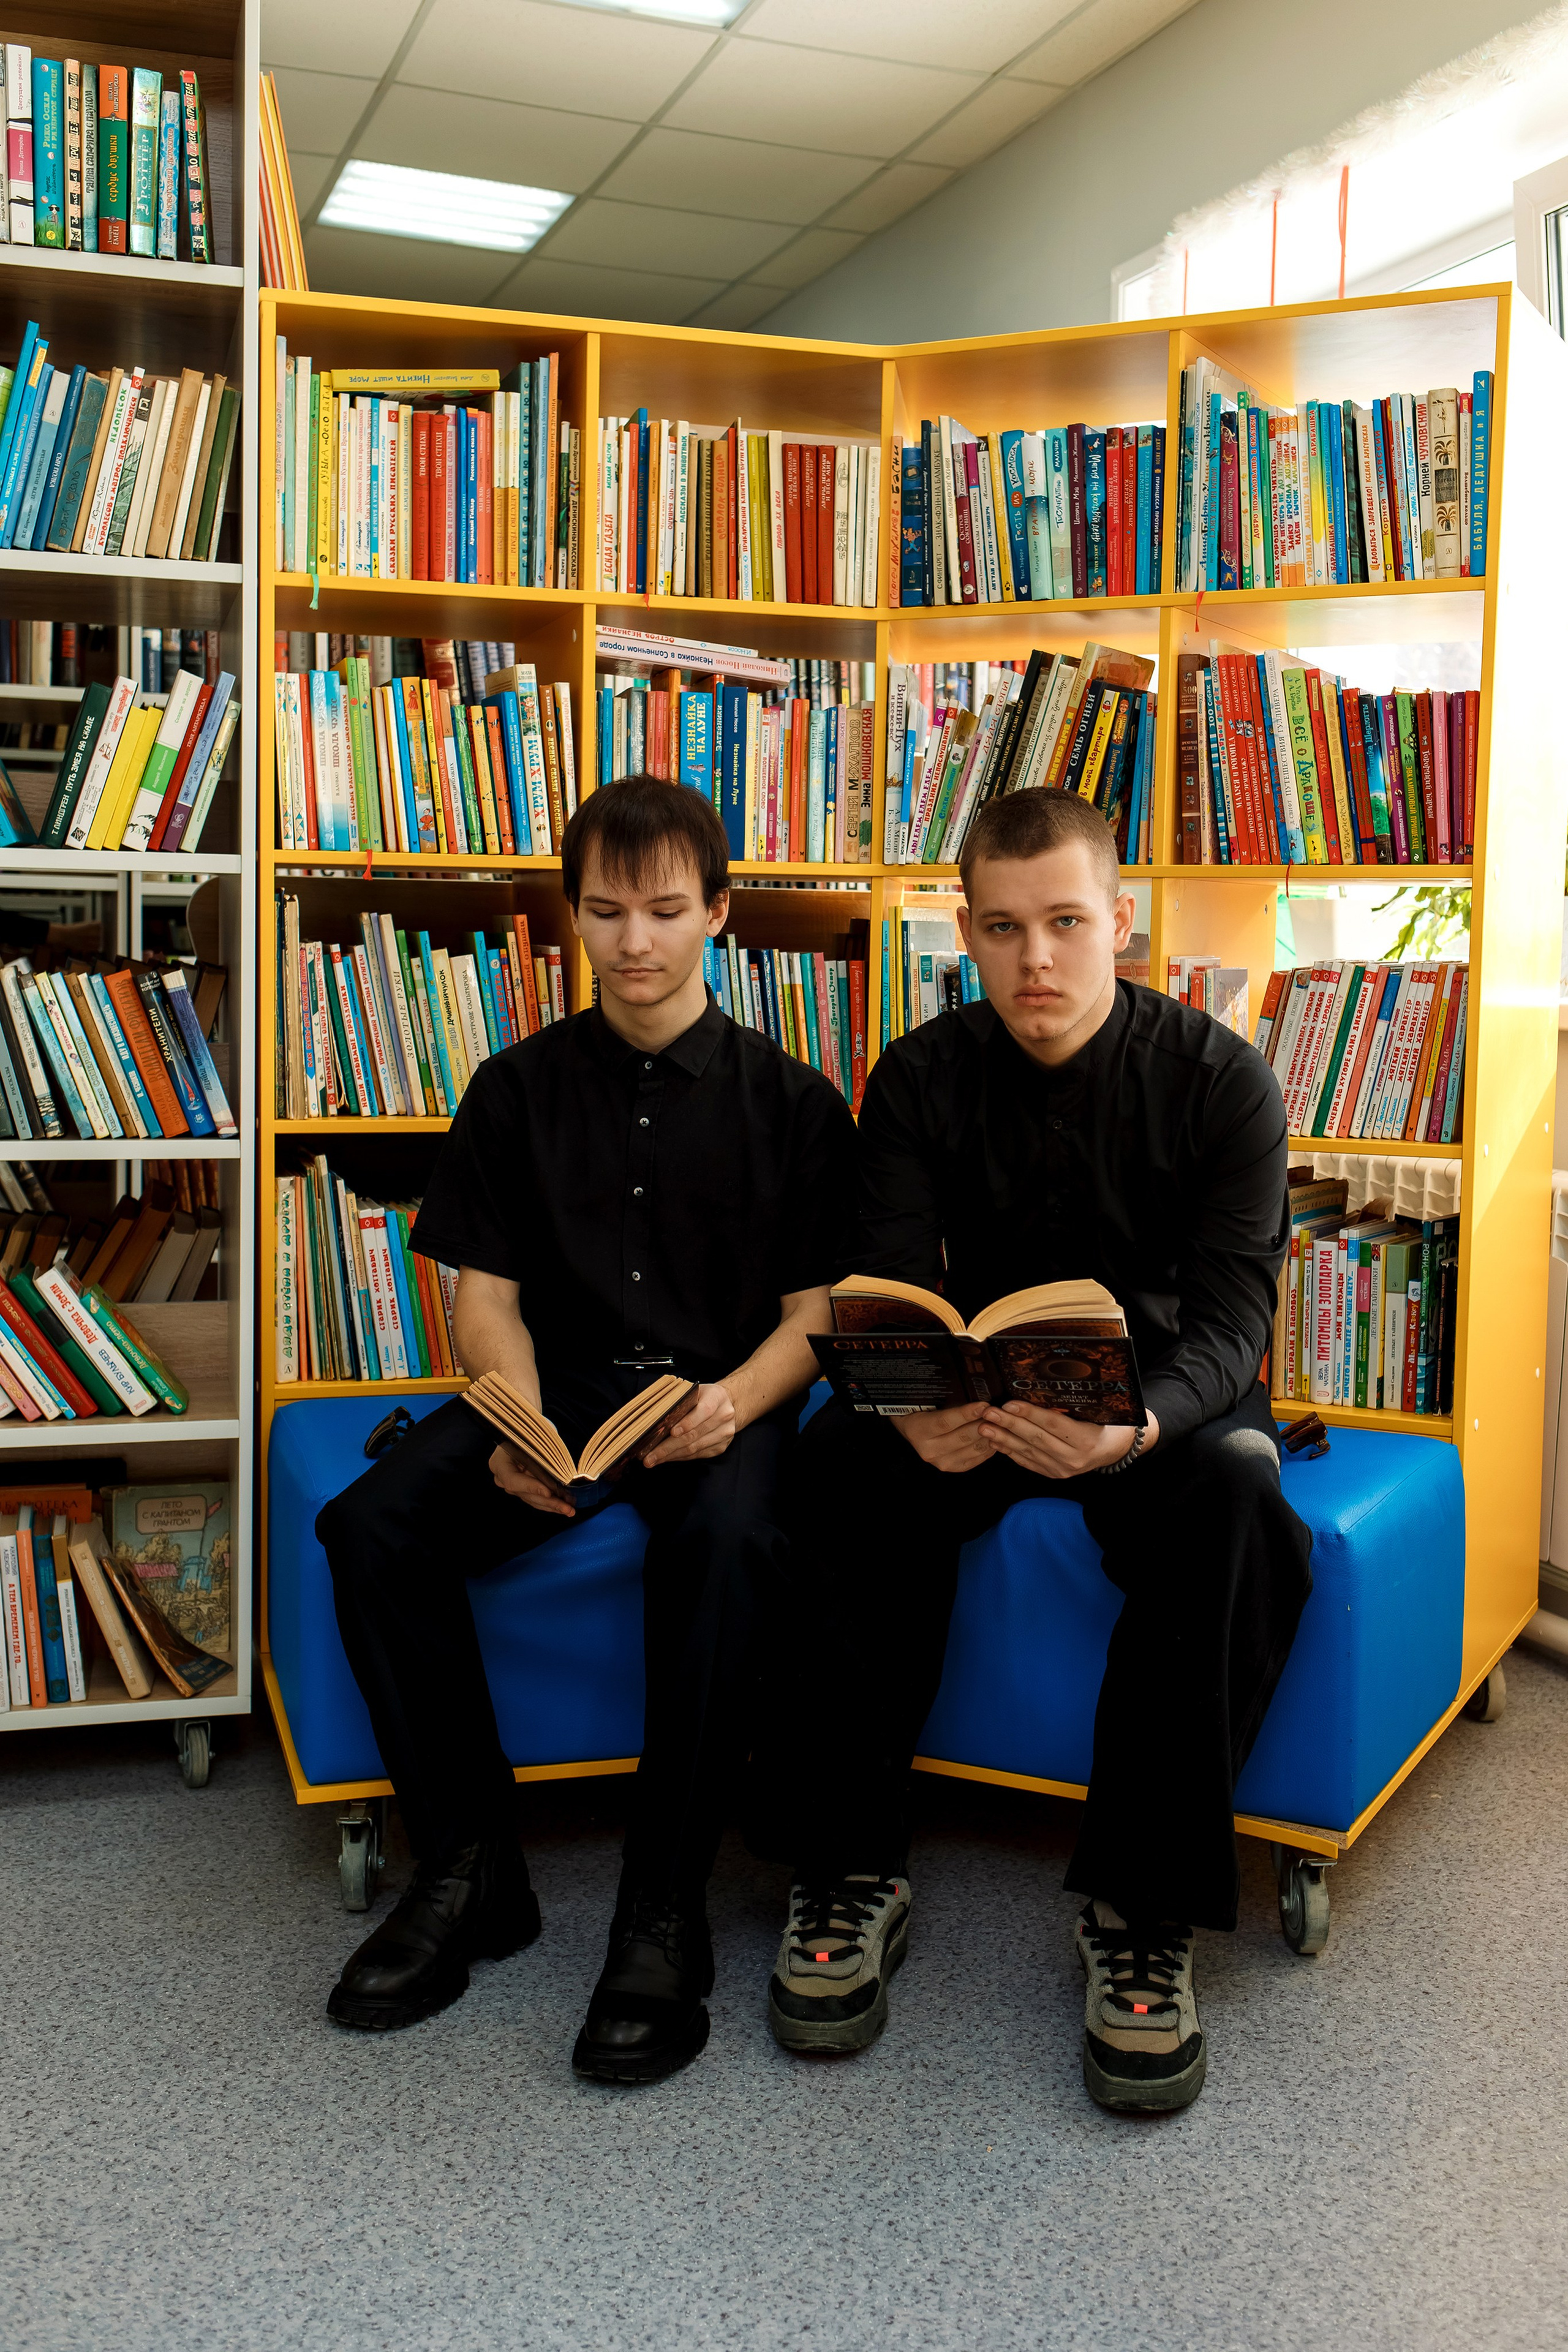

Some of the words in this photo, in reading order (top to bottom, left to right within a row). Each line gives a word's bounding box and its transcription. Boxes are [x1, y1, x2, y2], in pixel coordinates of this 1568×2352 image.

[189, 158, 200, 183] ДЕЛО
[1417, 404, 1428, 460] ЧУКОВСКИЙ
[1420, 462, 1431, 497] Корней
[1474, 436, 1485, 493] ДЕДУШКА
[1013, 493, 1021, 505] ИЗ
[1365, 486, 1376, 526] ЗАПРЕЩЕНО!
[1473, 500, 1483, 549] БАБУЛЯ,
[600, 641, 625, 650] городе
[627, 646, 669, 658] Солнечном
[677, 654, 713, 666] Незнайка
[715, 658, 740, 669] Носов
[742, 662, 777, 675] Николай
[686, 695, 696, 760] НЕЗНАЙКА
[696, 703, 706, 734] ЛУНЕ
[893, 684, 905, 752] Винни-Пух
[1273, 688, 1284, 733] ГУЛЛИВЕРА
[862, 709, 872, 780] МОШКОВСКАЯ
[1069, 736, 1084, 766] СЕМЬ
[1079, 692, 1096, 731] ОГНЕЙ
[1088, 726, 1105, 766] квартире
[71, 752, 83, 772] ЗМЕЯ
[847, 720, 859, 790] МИХАЛКОВ
[980, 785, 989, 801] НОВЫЕ
[986, 747, 1000, 783] ПРИКЛЮЧЕНИЯ
[995, 712, 1010, 746] ЭЛЕКТРОНИКА
[1278, 736, 1292, 796] ПУТЕШЕСТВИЯ
[66, 774, 77, 791] ПУТЬ
[527, 739, 545, 818] ХРУМ-ХРУМ
[862, 783, 872, 808] Эмма
[1084, 769, 1094, 790] моей
[53, 794, 69, 829] ЛИНДГРЕН
[552, 800, 562, 835] РАССКАЗЫ
[846, 796, 858, 837] СЕРГЕЙ
[393, 971, 404, 998] РУКИ
[148, 1008, 173, 1061] ХРАНИТЕЛИ
[398, 1005, 414, 1058] ЗОЛОТЫЕ
[468, 1011, 478, 1039] ОСТРОВЕ
[50, 1283, 70, 1306] Земли
[1317, 1250, 1332, 1305] ЗООПАРКА
[71, 1312, 99, 1344] Девочка
[1317, 1308, 1332, 1361] ПИТОМЦЫ
[99, 1349, 127, 1381] БУЛЫЧЕВ
[123, 1381, 135, 1395] КИР
[151, 1510, 201, 1518] КАПИТАНОМ
